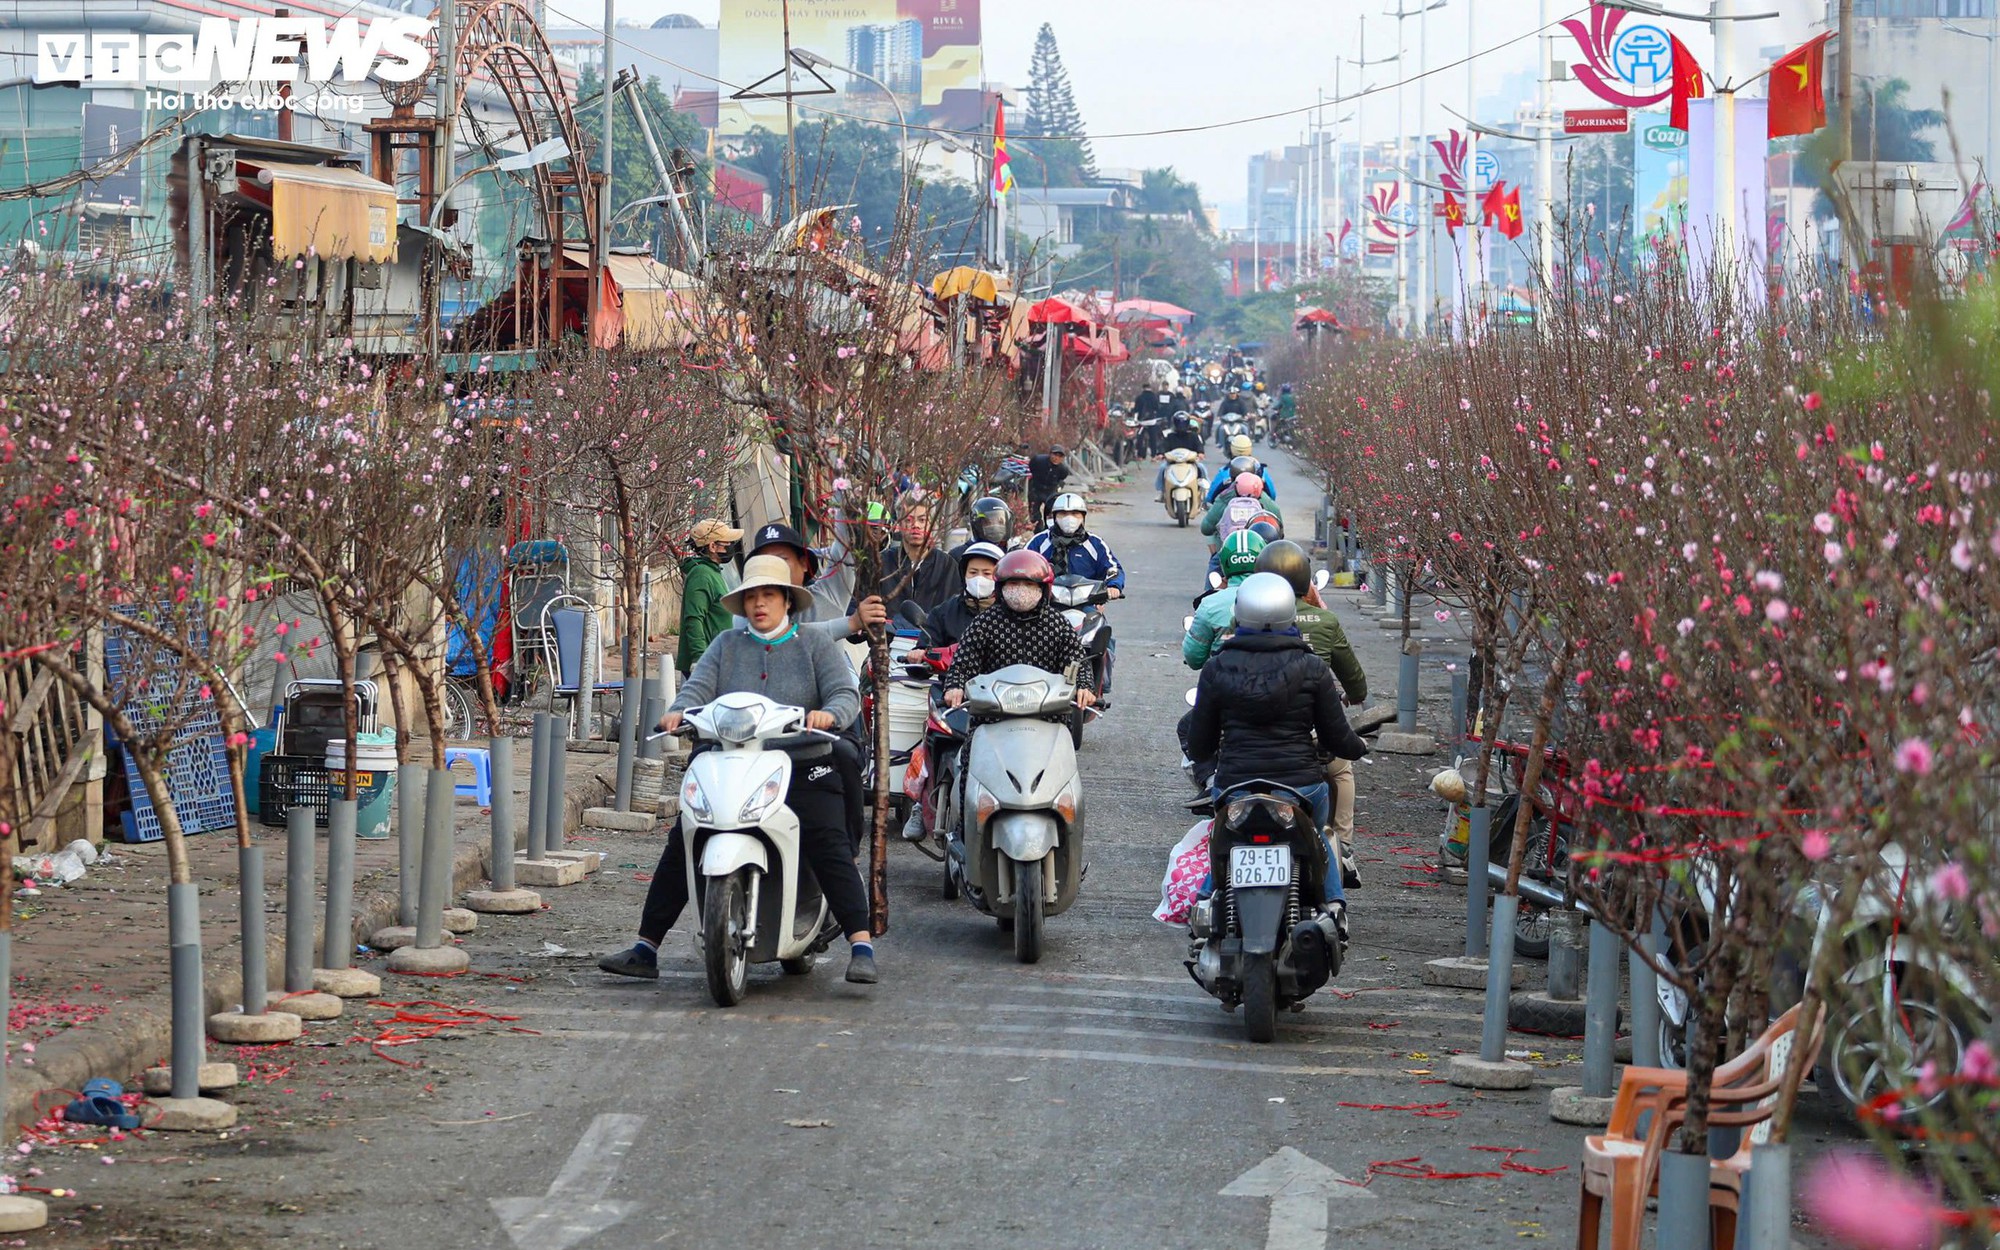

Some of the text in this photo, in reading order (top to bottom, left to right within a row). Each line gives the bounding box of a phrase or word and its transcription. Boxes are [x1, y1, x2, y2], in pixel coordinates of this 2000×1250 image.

[932, 16, 964, 25] RIVEA
[1576, 117, 1627, 127] AGRIBANK
[1647, 128, 1685, 147] Cozy
[765, 526, 780, 539] LA
[1230, 553, 1256, 564] Grab
[1240, 849, 1280, 866] 29-E1
[1235, 867, 1286, 884] 826.70
